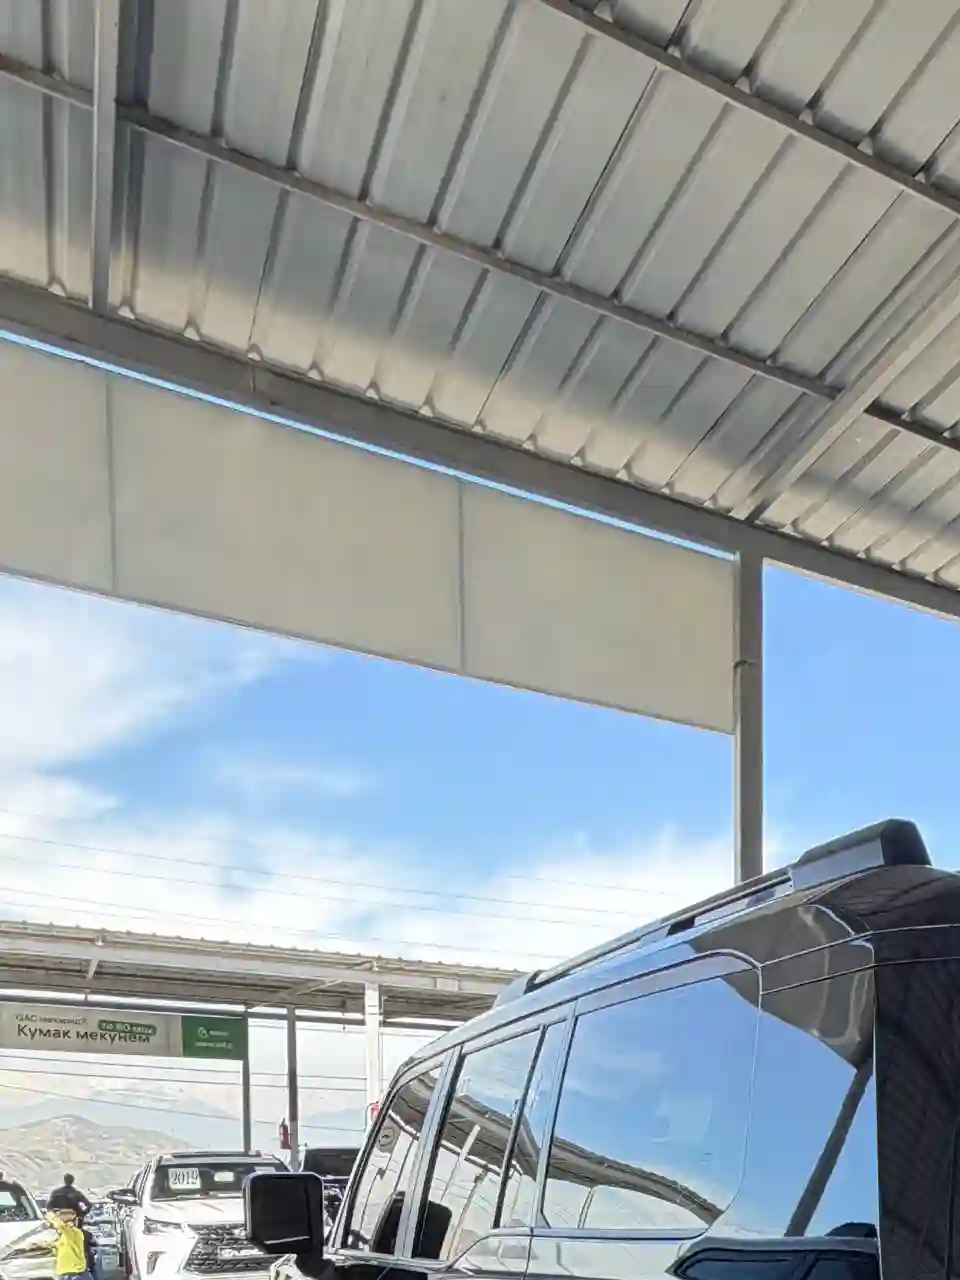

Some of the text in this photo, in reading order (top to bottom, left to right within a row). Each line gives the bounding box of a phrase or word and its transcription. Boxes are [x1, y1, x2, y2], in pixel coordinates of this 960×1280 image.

[17, 1023, 151, 1045] Кумак мекунем
[172, 1168, 198, 1185] 2019
